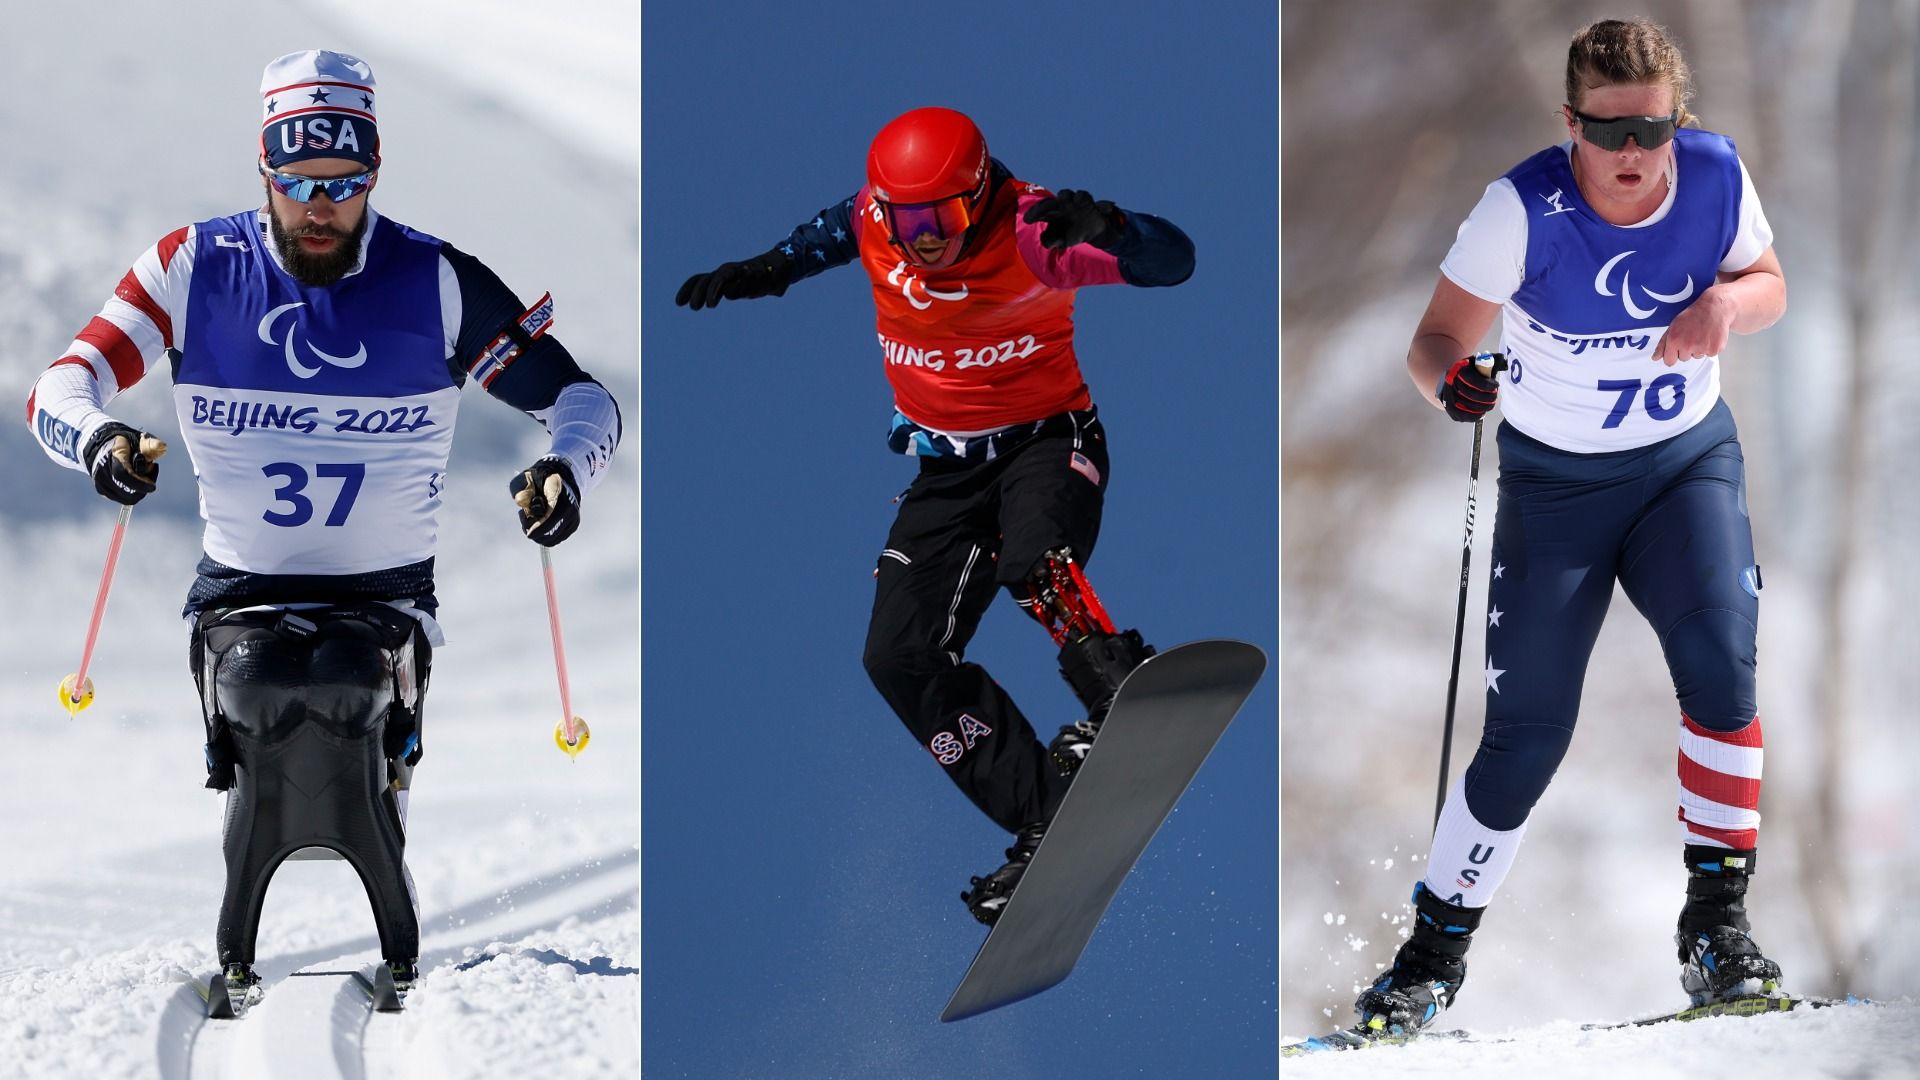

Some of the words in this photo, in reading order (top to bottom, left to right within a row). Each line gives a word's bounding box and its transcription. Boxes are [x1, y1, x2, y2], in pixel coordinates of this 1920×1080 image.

[281, 118, 359, 154] USA
[522, 297, 554, 335] ARSE
[954, 334, 1046, 370] 2022
[191, 395, 320, 437] BEIJING
[334, 405, 437, 434] 2022
[1597, 373, 1687, 429] 70
[43, 415, 76, 459] USA
[261, 462, 366, 527] 37
[428, 472, 445, 499] 3
[1463, 476, 1478, 551] SWIX
[1446, 843, 1495, 907] USA
